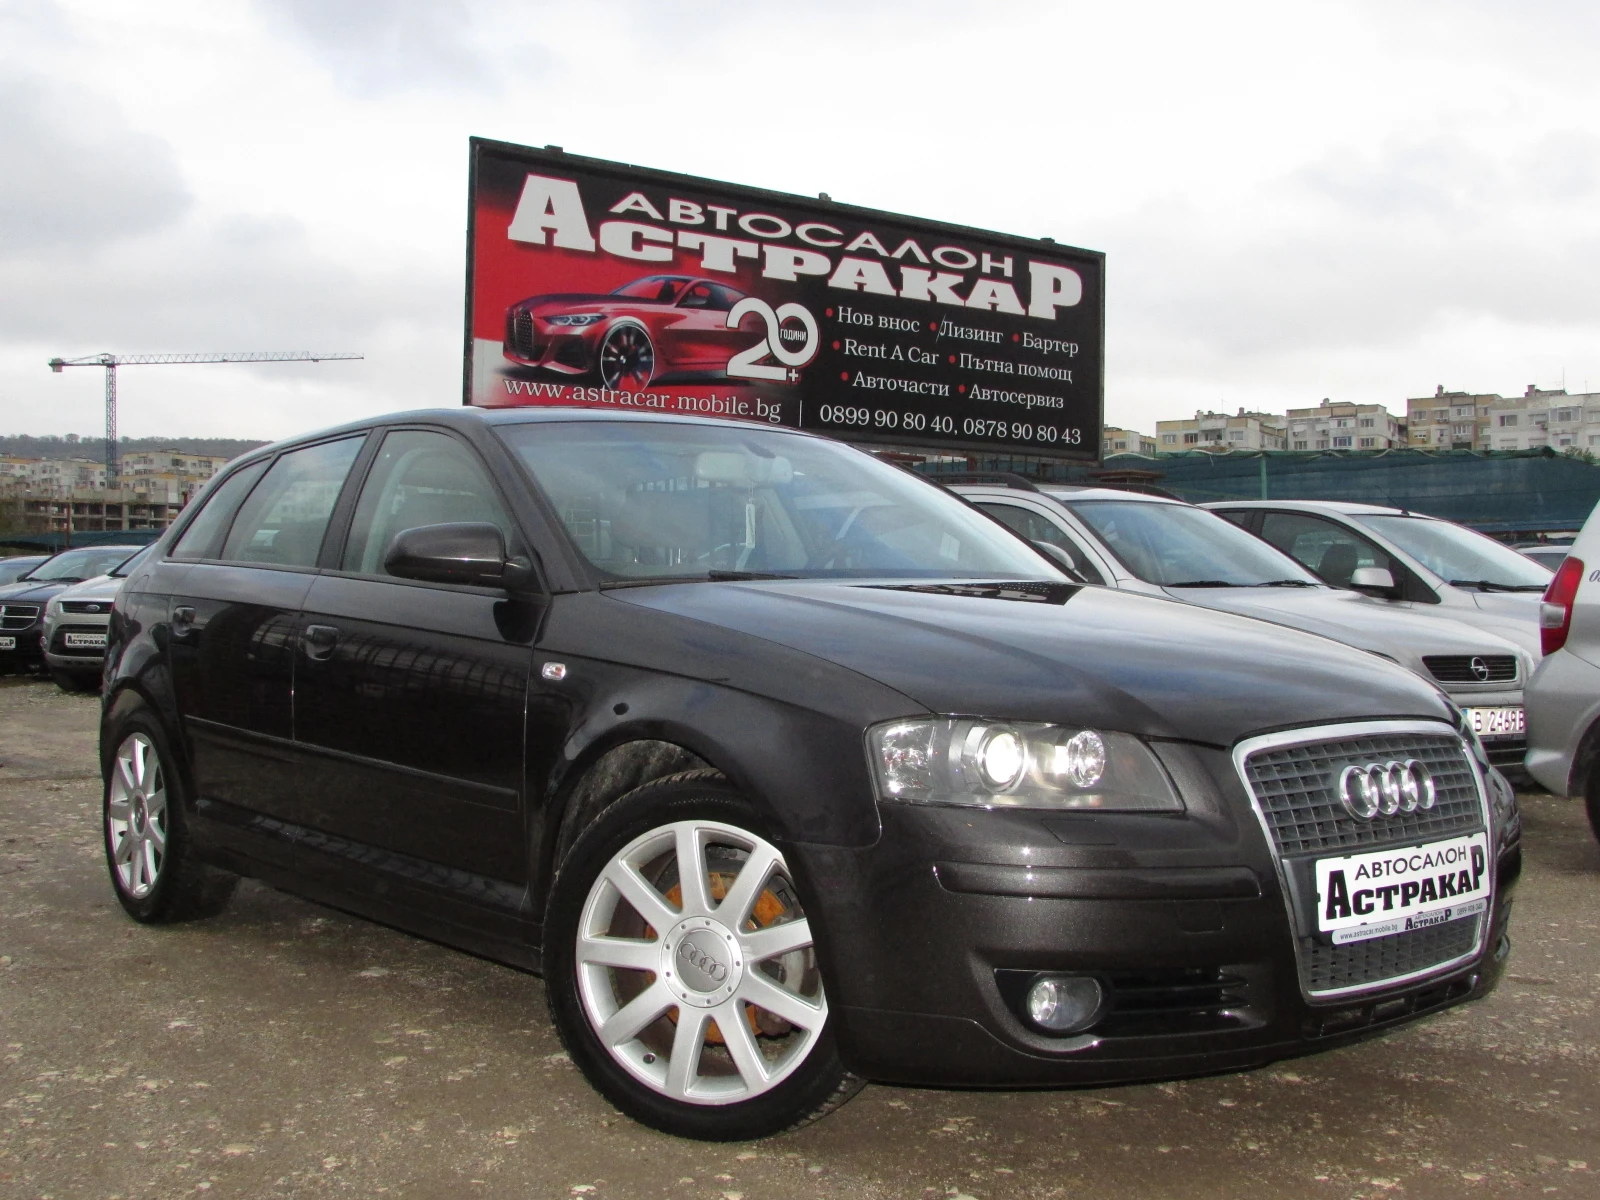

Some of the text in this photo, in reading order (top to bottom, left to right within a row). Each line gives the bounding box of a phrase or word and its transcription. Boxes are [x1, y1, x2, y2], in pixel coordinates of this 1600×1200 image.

[507, 173, 1083, 320] АСТРАКАР
[609, 192, 1013, 277] АВТОСАЛОН
[837, 306, 920, 333] Нов внос
[780, 328, 807, 342] ГОДИНИ
[1022, 332, 1079, 356] Бартер
[844, 339, 940, 365] Rent A Car
[959, 353, 1073, 384] Пътна помощ
[852, 371, 950, 397] Авточасти
[969, 384, 1065, 410] Автосервиз
[503, 379, 782, 423] www.astracar.mobile.bg
[819, 404, 1083, 445] 0899 90 80 40, 0878 90 80 43
[1354, 846, 1467, 881] АВТОСАЛОН
[1326, 844, 1485, 920] АСТРАКАР
[1340, 924, 1398, 939] www.astracar.mobile.bg
